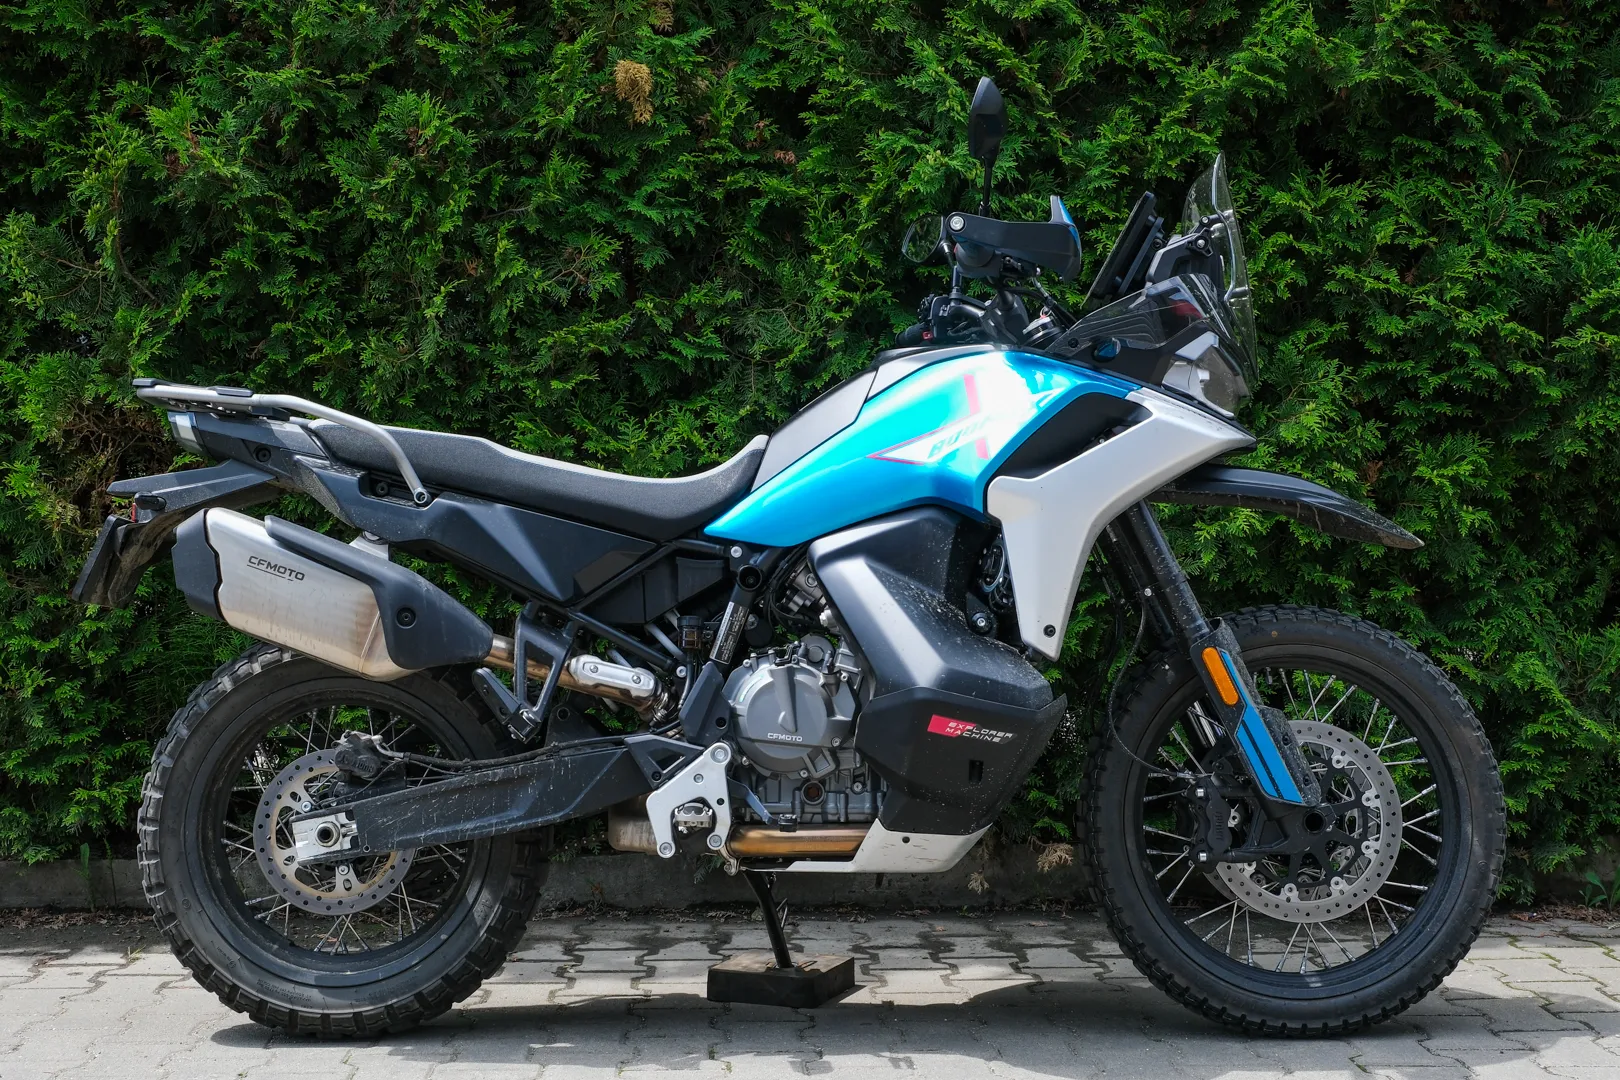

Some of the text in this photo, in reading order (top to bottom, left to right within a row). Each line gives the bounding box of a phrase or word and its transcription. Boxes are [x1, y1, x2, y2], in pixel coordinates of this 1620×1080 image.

[248, 556, 306, 581] CFMOTO
[767, 732, 803, 742] CFMOTO
[945, 728, 1002, 743] MACHINE
[948, 722, 1014, 738] EXPLORER
